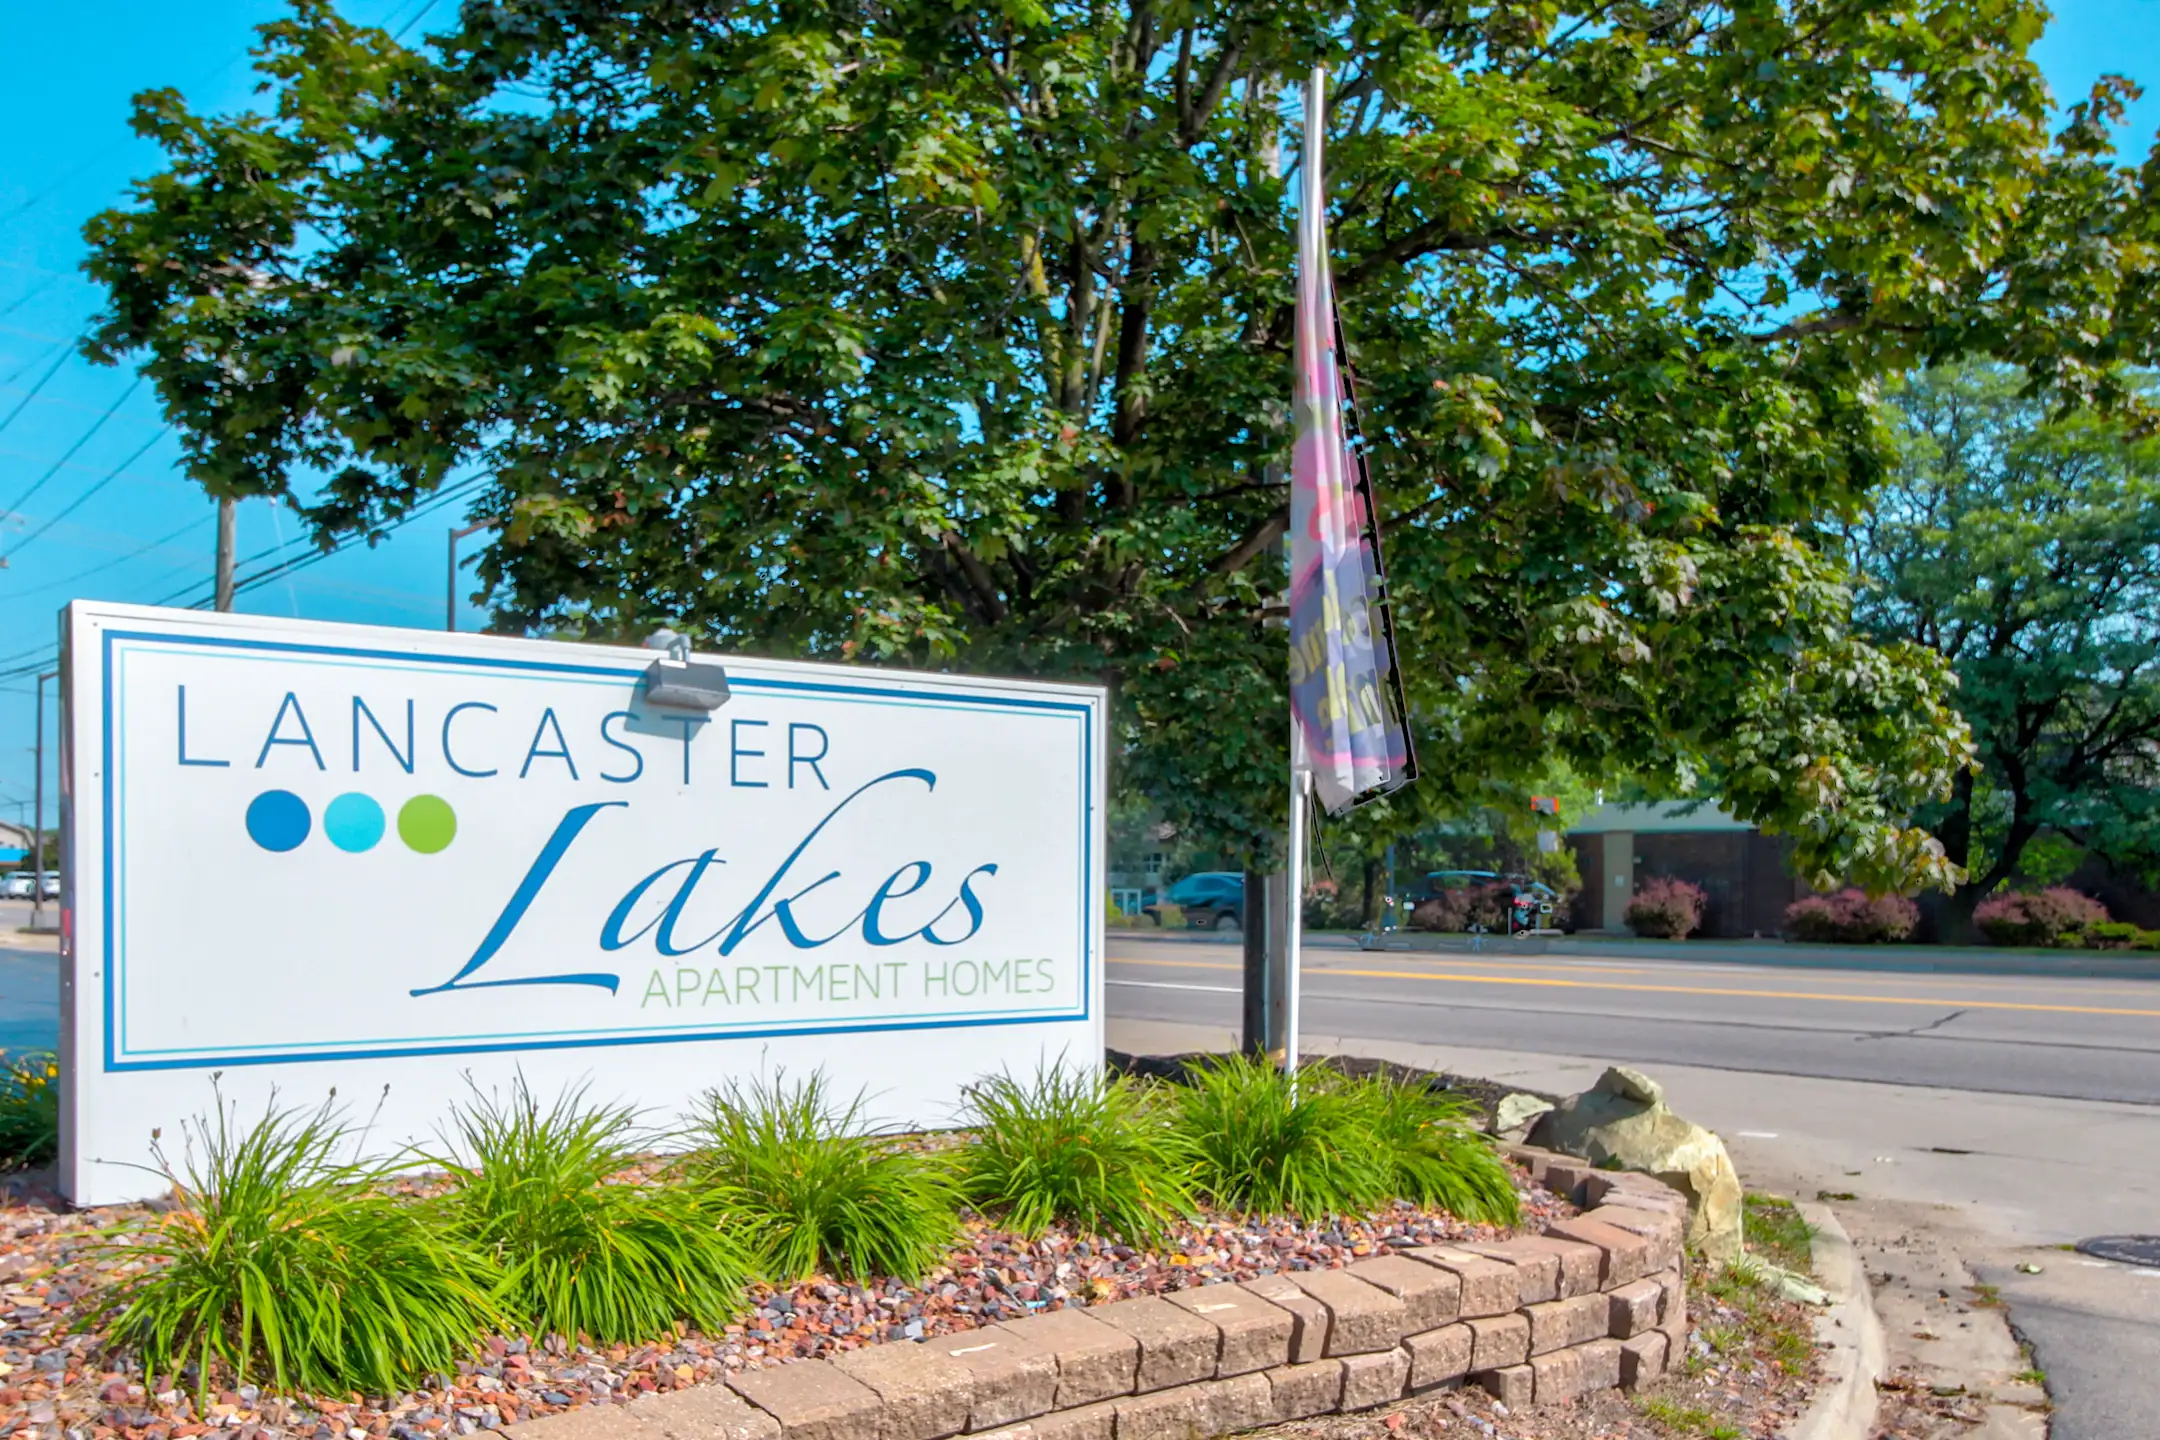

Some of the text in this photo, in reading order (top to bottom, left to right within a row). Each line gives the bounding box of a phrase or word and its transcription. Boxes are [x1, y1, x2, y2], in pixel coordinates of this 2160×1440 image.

[178, 684, 831, 790] LANCASTER
[410, 768, 999, 998] Lakes
[641, 957, 1056, 1009] APARTMENT HOMES
